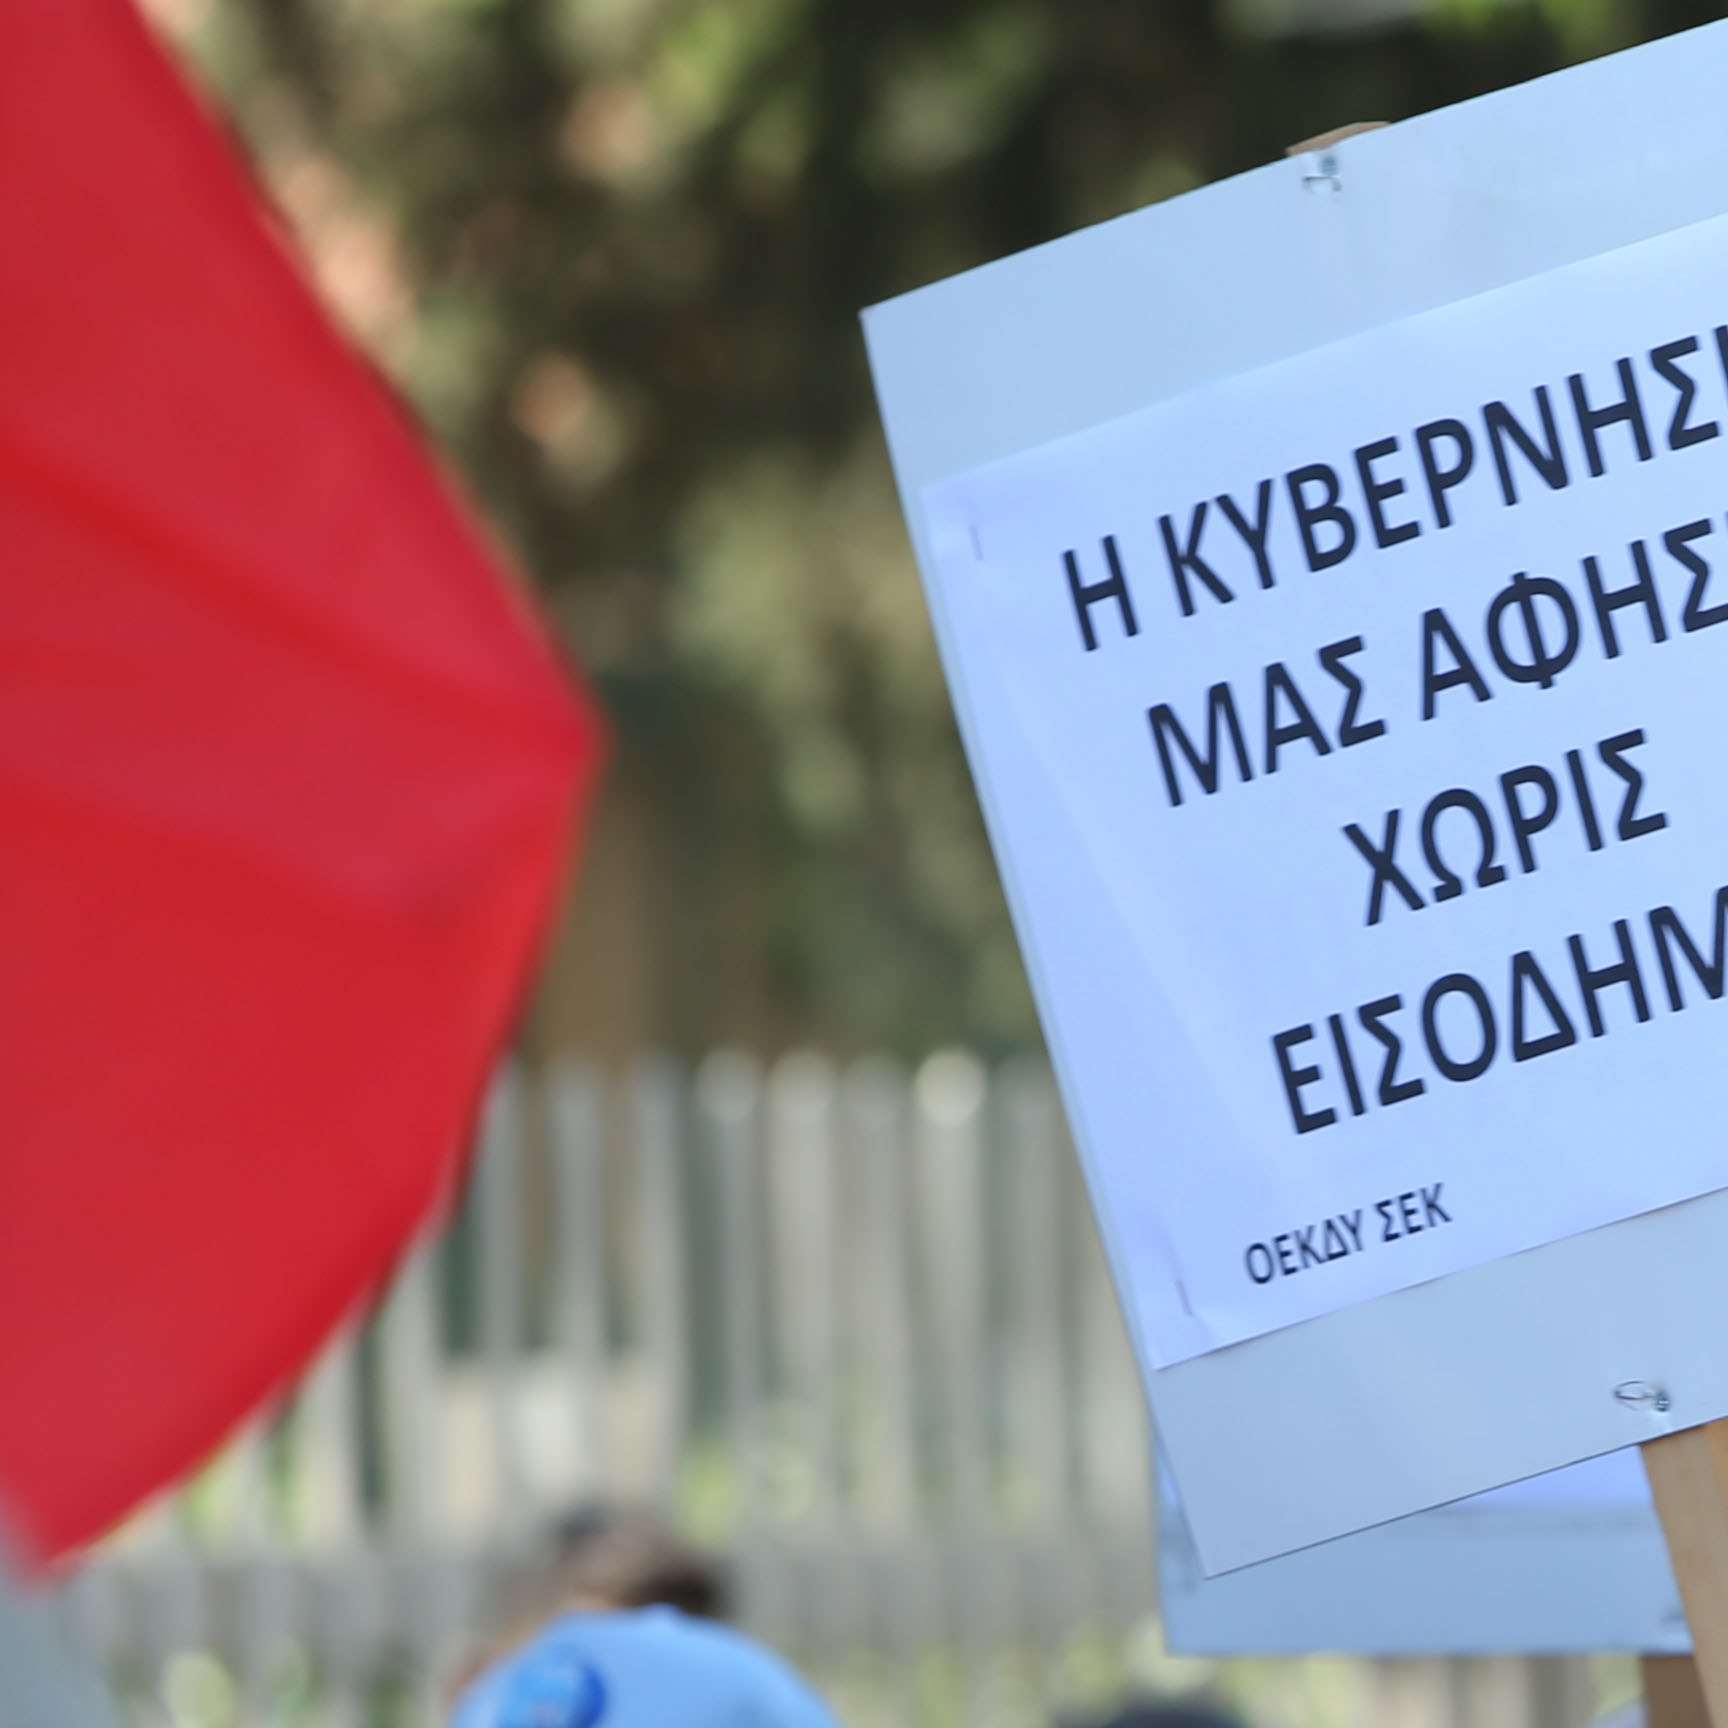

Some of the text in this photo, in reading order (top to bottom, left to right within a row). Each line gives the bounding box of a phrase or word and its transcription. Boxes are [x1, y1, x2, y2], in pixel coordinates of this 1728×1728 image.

[1062, 534, 1141, 653] Η
[1146, 634, 1389, 808] ΜΑΣ
[1341, 727, 1670, 928] ΧΩΡΙΣ
[1244, 1181, 1454, 1287] ΟΕΚΔΥ ΣΕΚ
